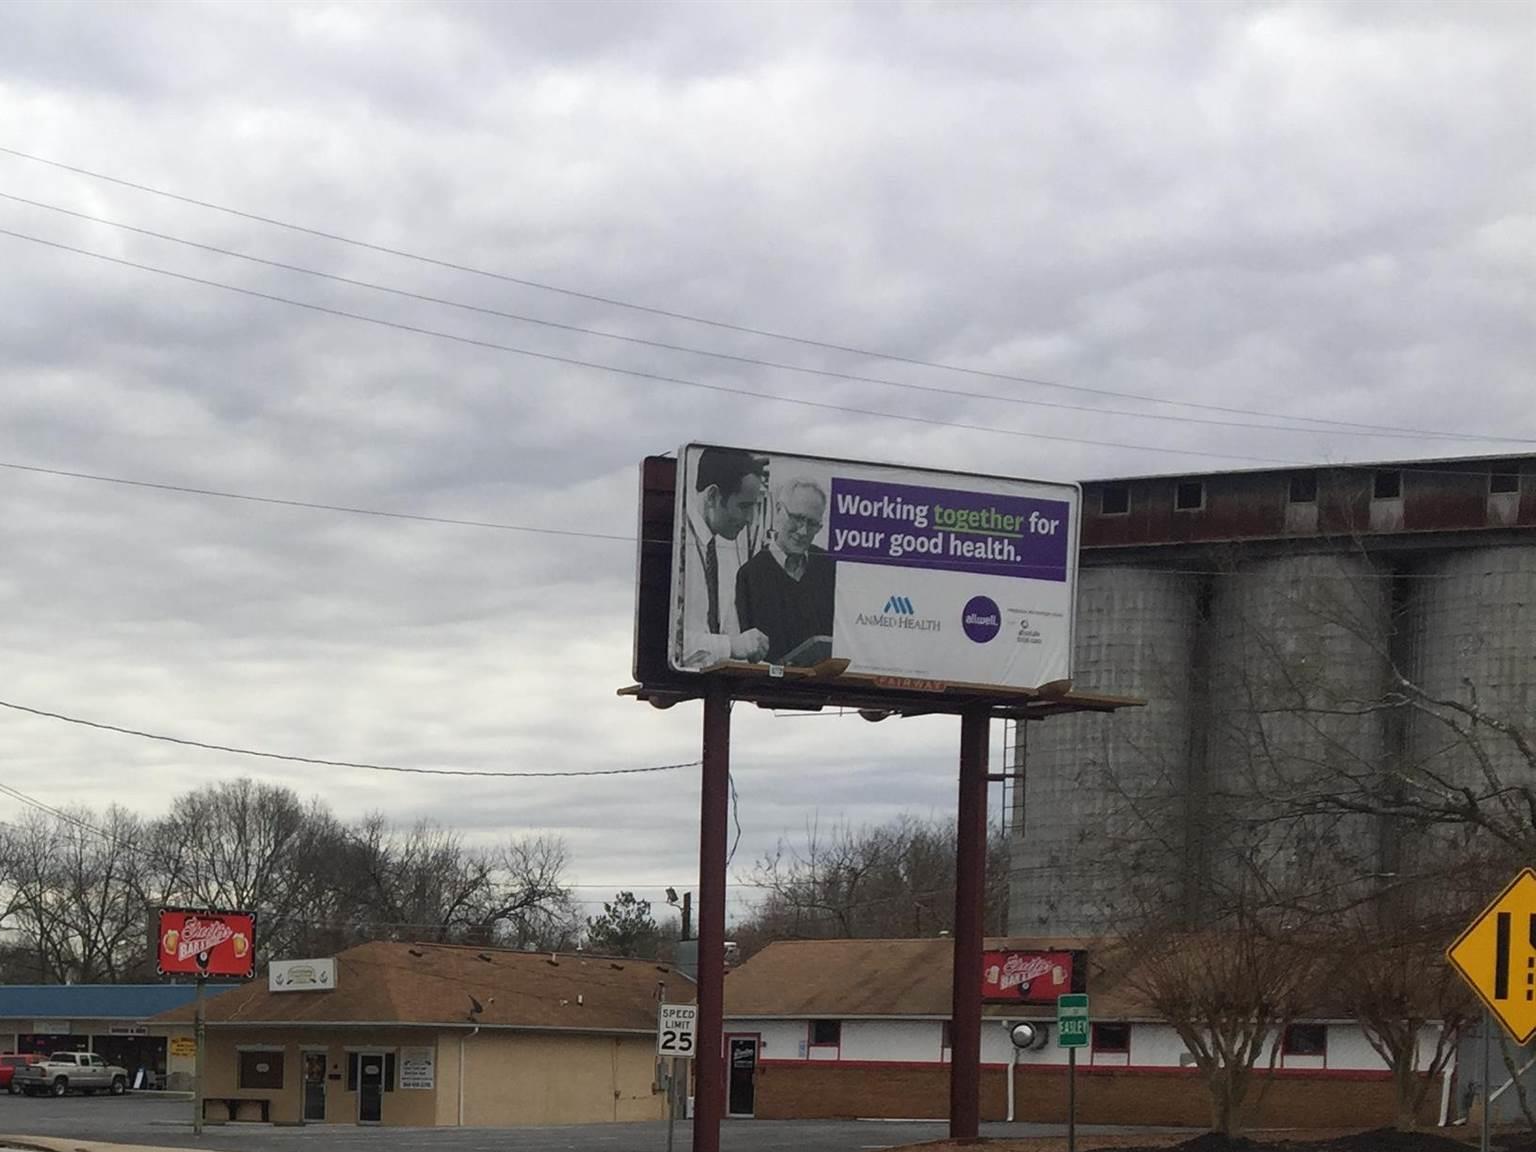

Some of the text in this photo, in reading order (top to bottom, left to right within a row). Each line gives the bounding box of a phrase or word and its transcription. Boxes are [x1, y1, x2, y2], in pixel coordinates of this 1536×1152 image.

[837, 494, 1059, 535] Working together for
[834, 528, 1022, 562] your good health.
[899, 616, 941, 632] HEALTH
[663, 1008, 695, 1019] SPEED
[665, 1020, 690, 1030] LIMIT
[661, 1030, 693, 1051] 25
